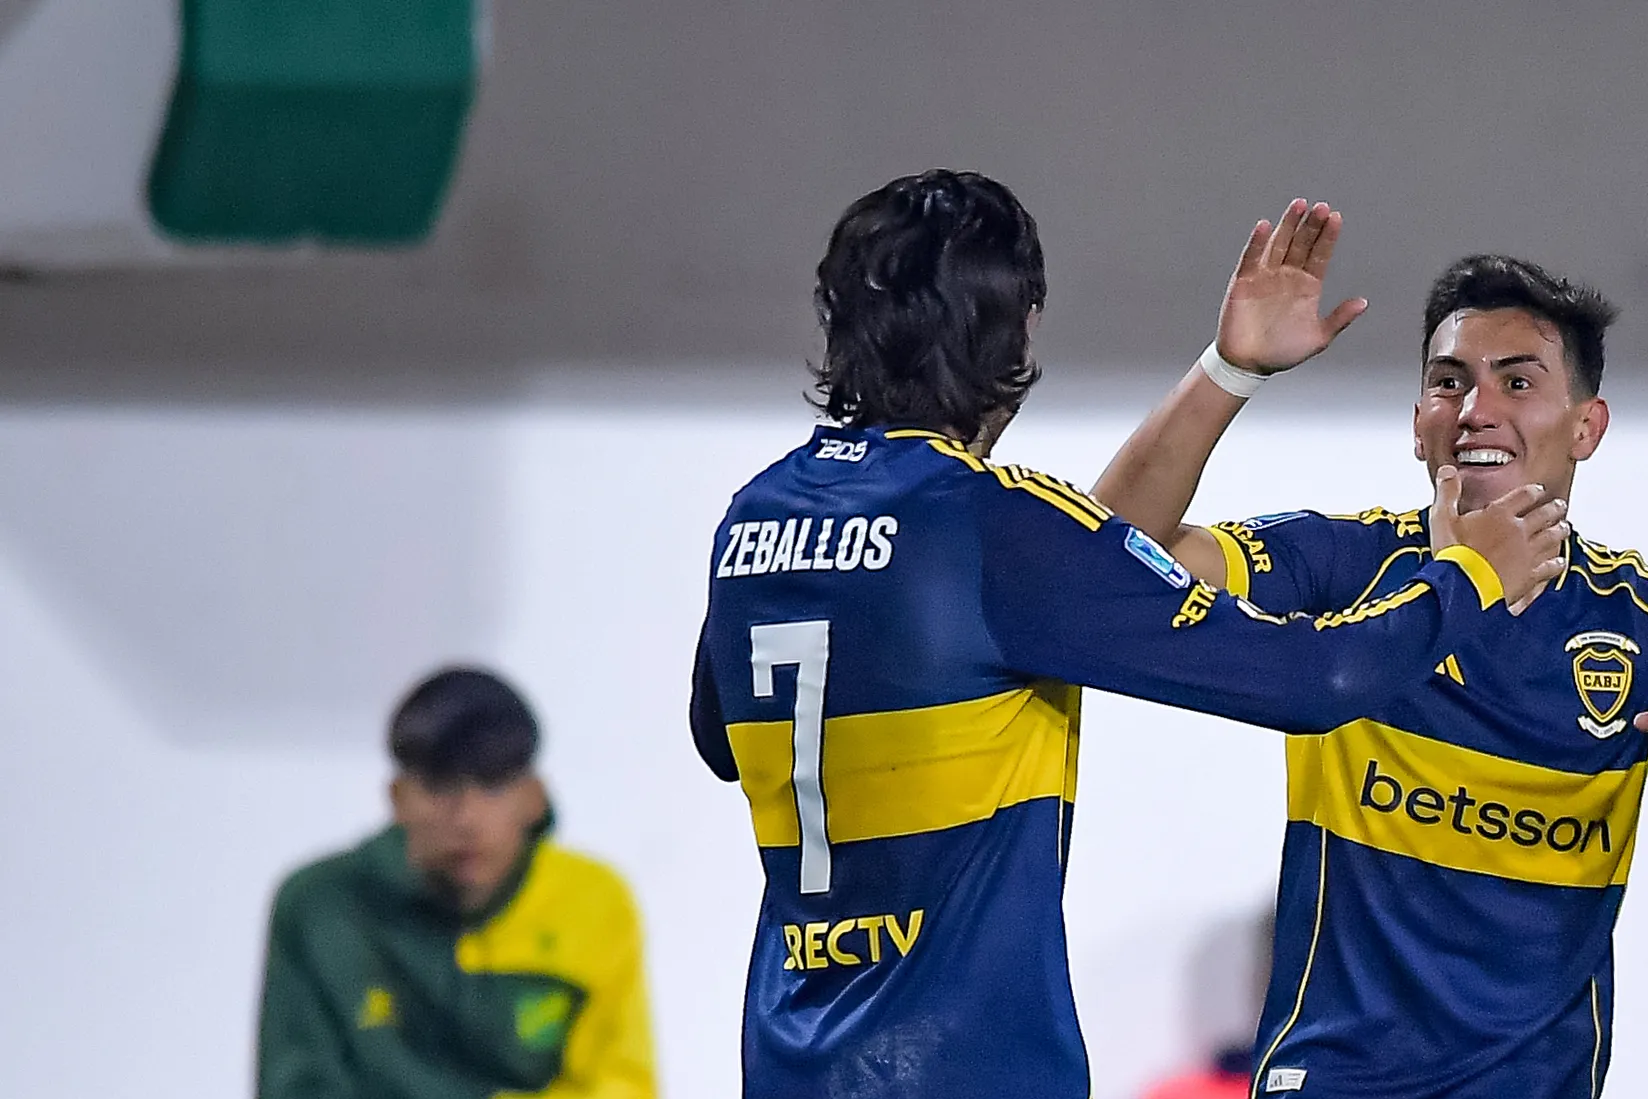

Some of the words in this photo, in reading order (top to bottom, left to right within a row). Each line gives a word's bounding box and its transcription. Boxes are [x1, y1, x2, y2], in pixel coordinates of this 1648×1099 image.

[716, 516, 898, 579] ZEBALLOS
[1583, 675, 1621, 688] CABJ
[751, 620, 831, 894] 7
[1360, 760, 1612, 853] betsson
